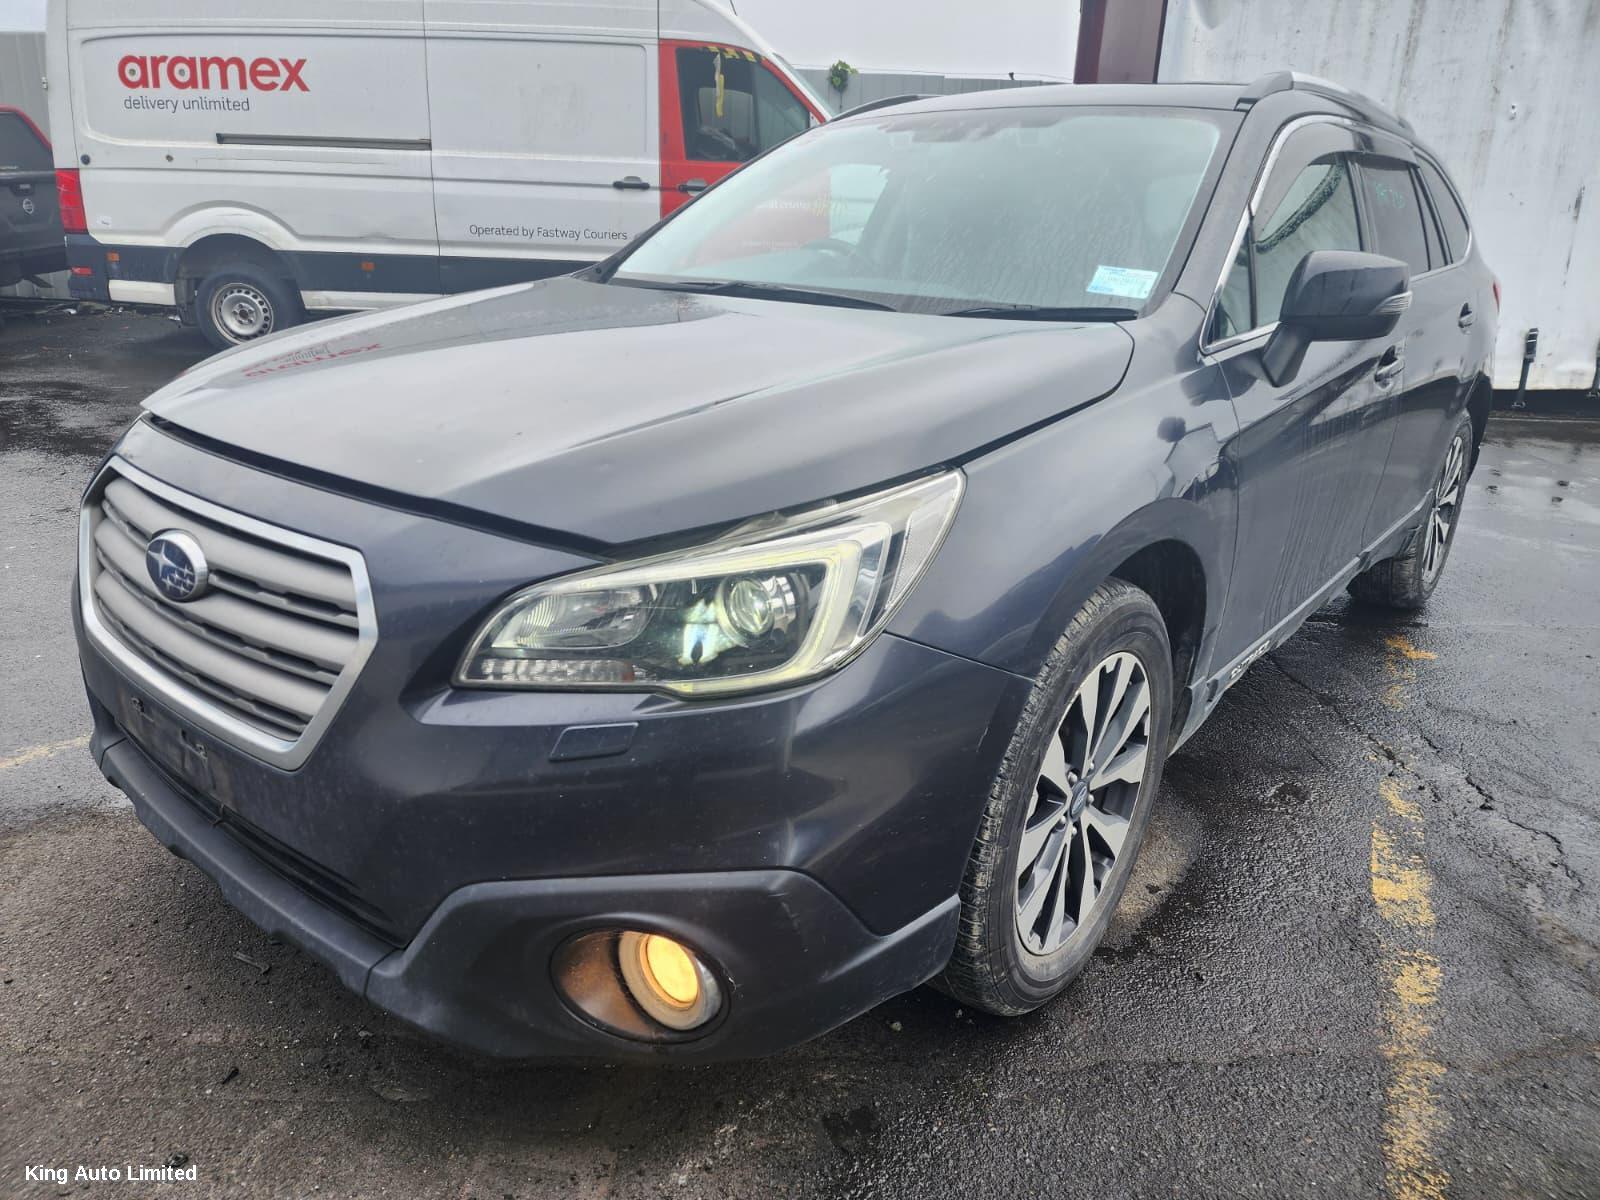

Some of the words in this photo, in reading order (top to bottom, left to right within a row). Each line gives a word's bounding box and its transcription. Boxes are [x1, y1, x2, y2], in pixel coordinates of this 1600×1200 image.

[117, 54, 310, 92] aramex
[123, 95, 178, 114] delivery
[183, 96, 250, 111] unlimited
[469, 224, 519, 236] Operated
[522, 226, 534, 238] by
[537, 226, 581, 240] Fastway
[583, 228, 628, 240] Couriers
